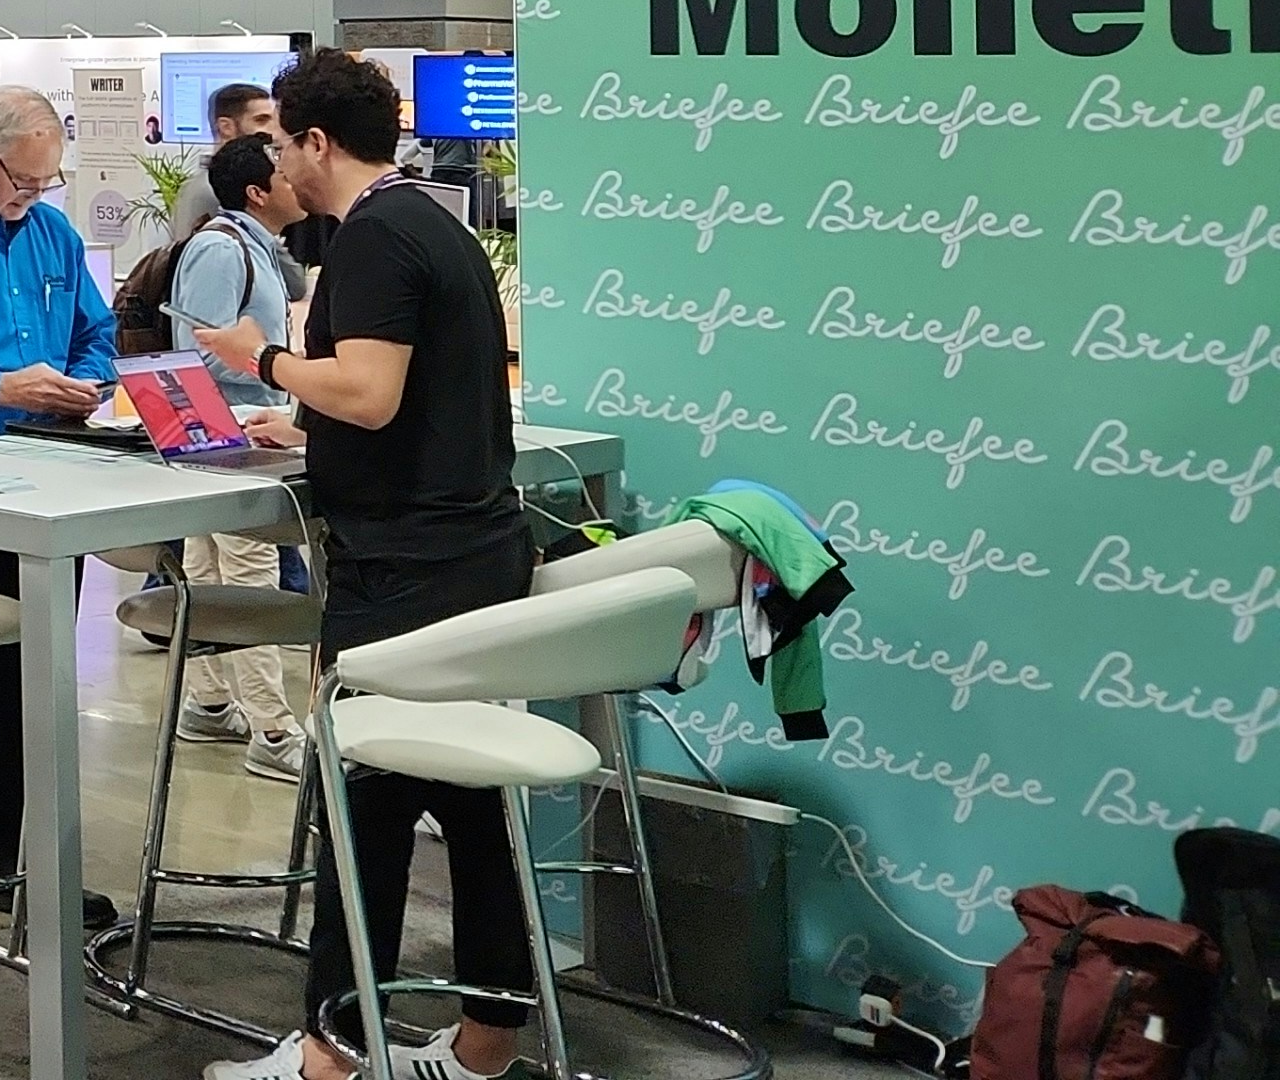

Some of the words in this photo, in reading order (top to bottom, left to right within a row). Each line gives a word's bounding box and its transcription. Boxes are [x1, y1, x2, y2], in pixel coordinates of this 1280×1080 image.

[47, 89, 74, 101] with
[90, 78, 124, 92] WRITER
[581, 72, 784, 152] Briefee
[804, 74, 1041, 160] Briefee
[96, 205, 124, 221] 53%
[582, 171, 785, 254] Briefee
[806, 180, 1044, 269] Briefee
[583, 270, 787, 356] Briefee
[808, 287, 1046, 379] Briefee
[585, 368, 789, 458] Briefee
[810, 393, 1048, 490] Briefee
[821, 500, 1051, 600] Briefee
[819, 608, 1054, 712] Briefee
[817, 716, 1056, 823] Briefee
